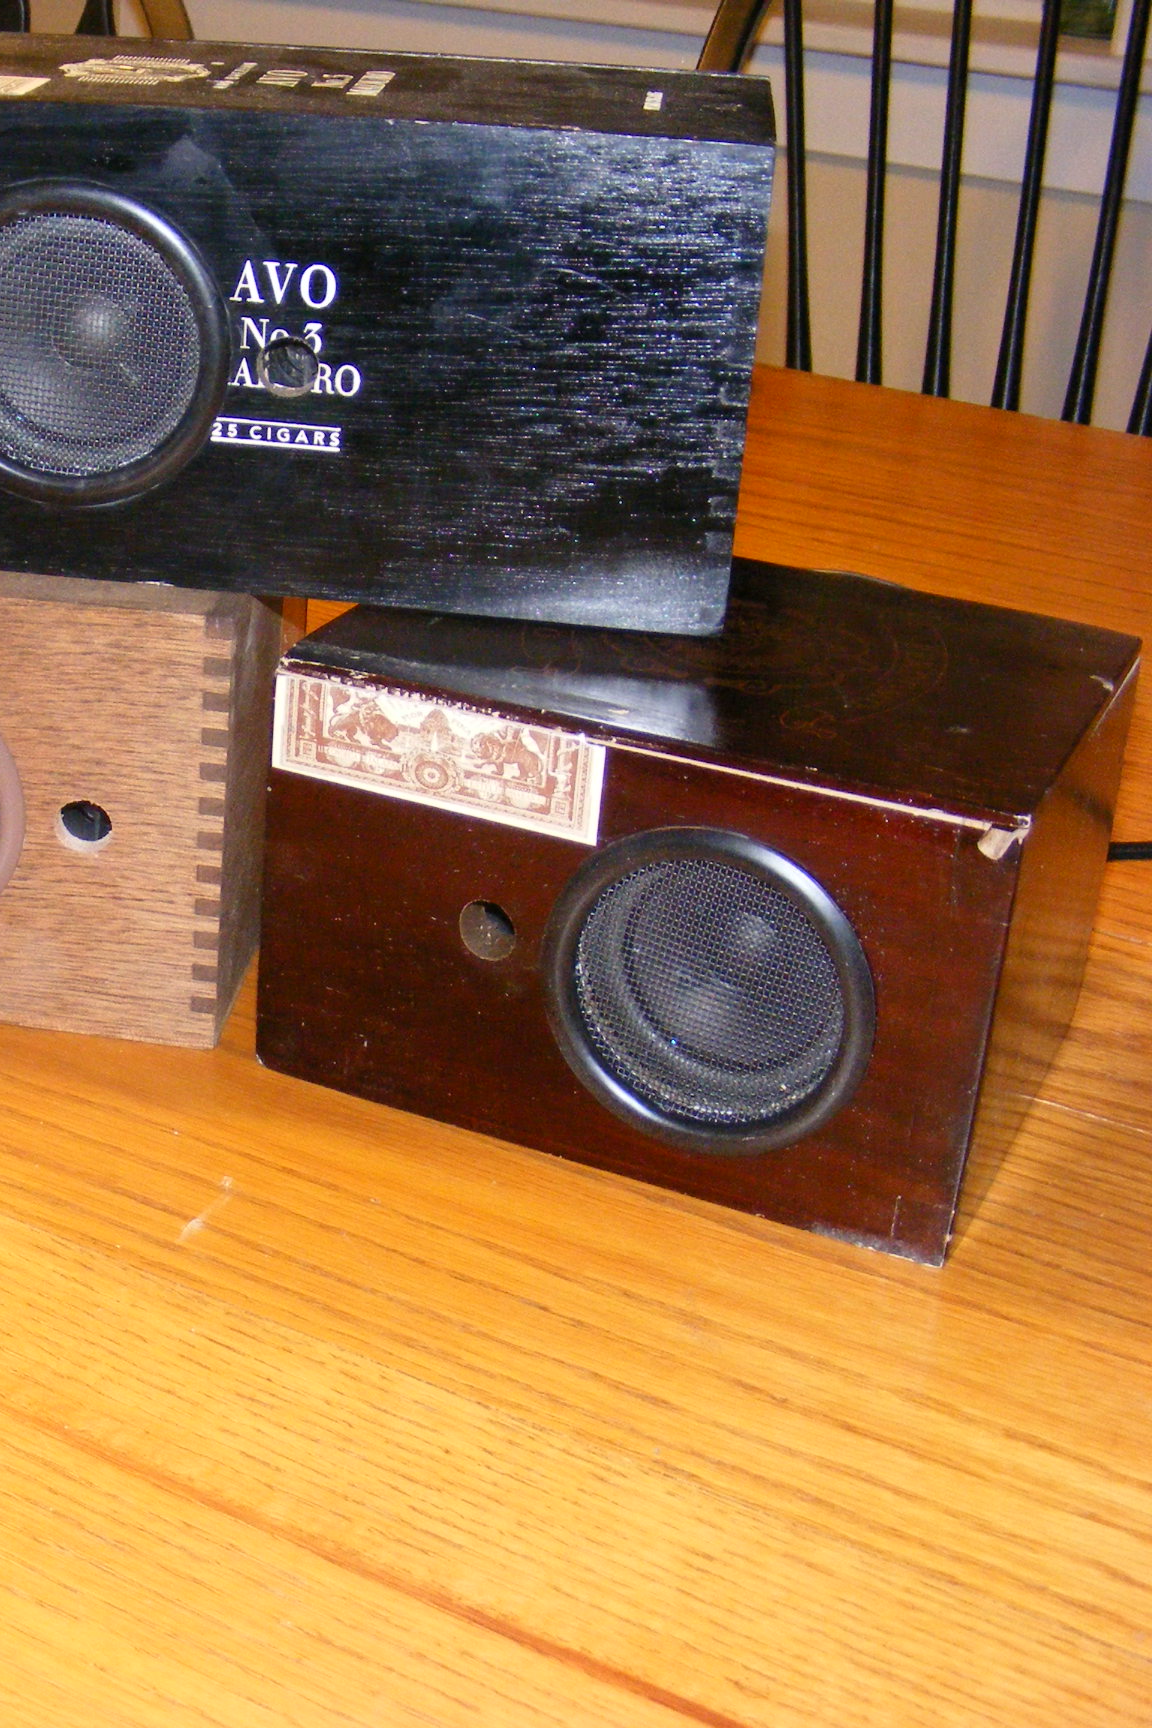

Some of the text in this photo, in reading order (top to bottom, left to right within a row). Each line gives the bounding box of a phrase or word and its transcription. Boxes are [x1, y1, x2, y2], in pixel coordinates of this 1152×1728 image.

[229, 260, 337, 309] AVO
[211, 422, 341, 447] 25 CIGARS
